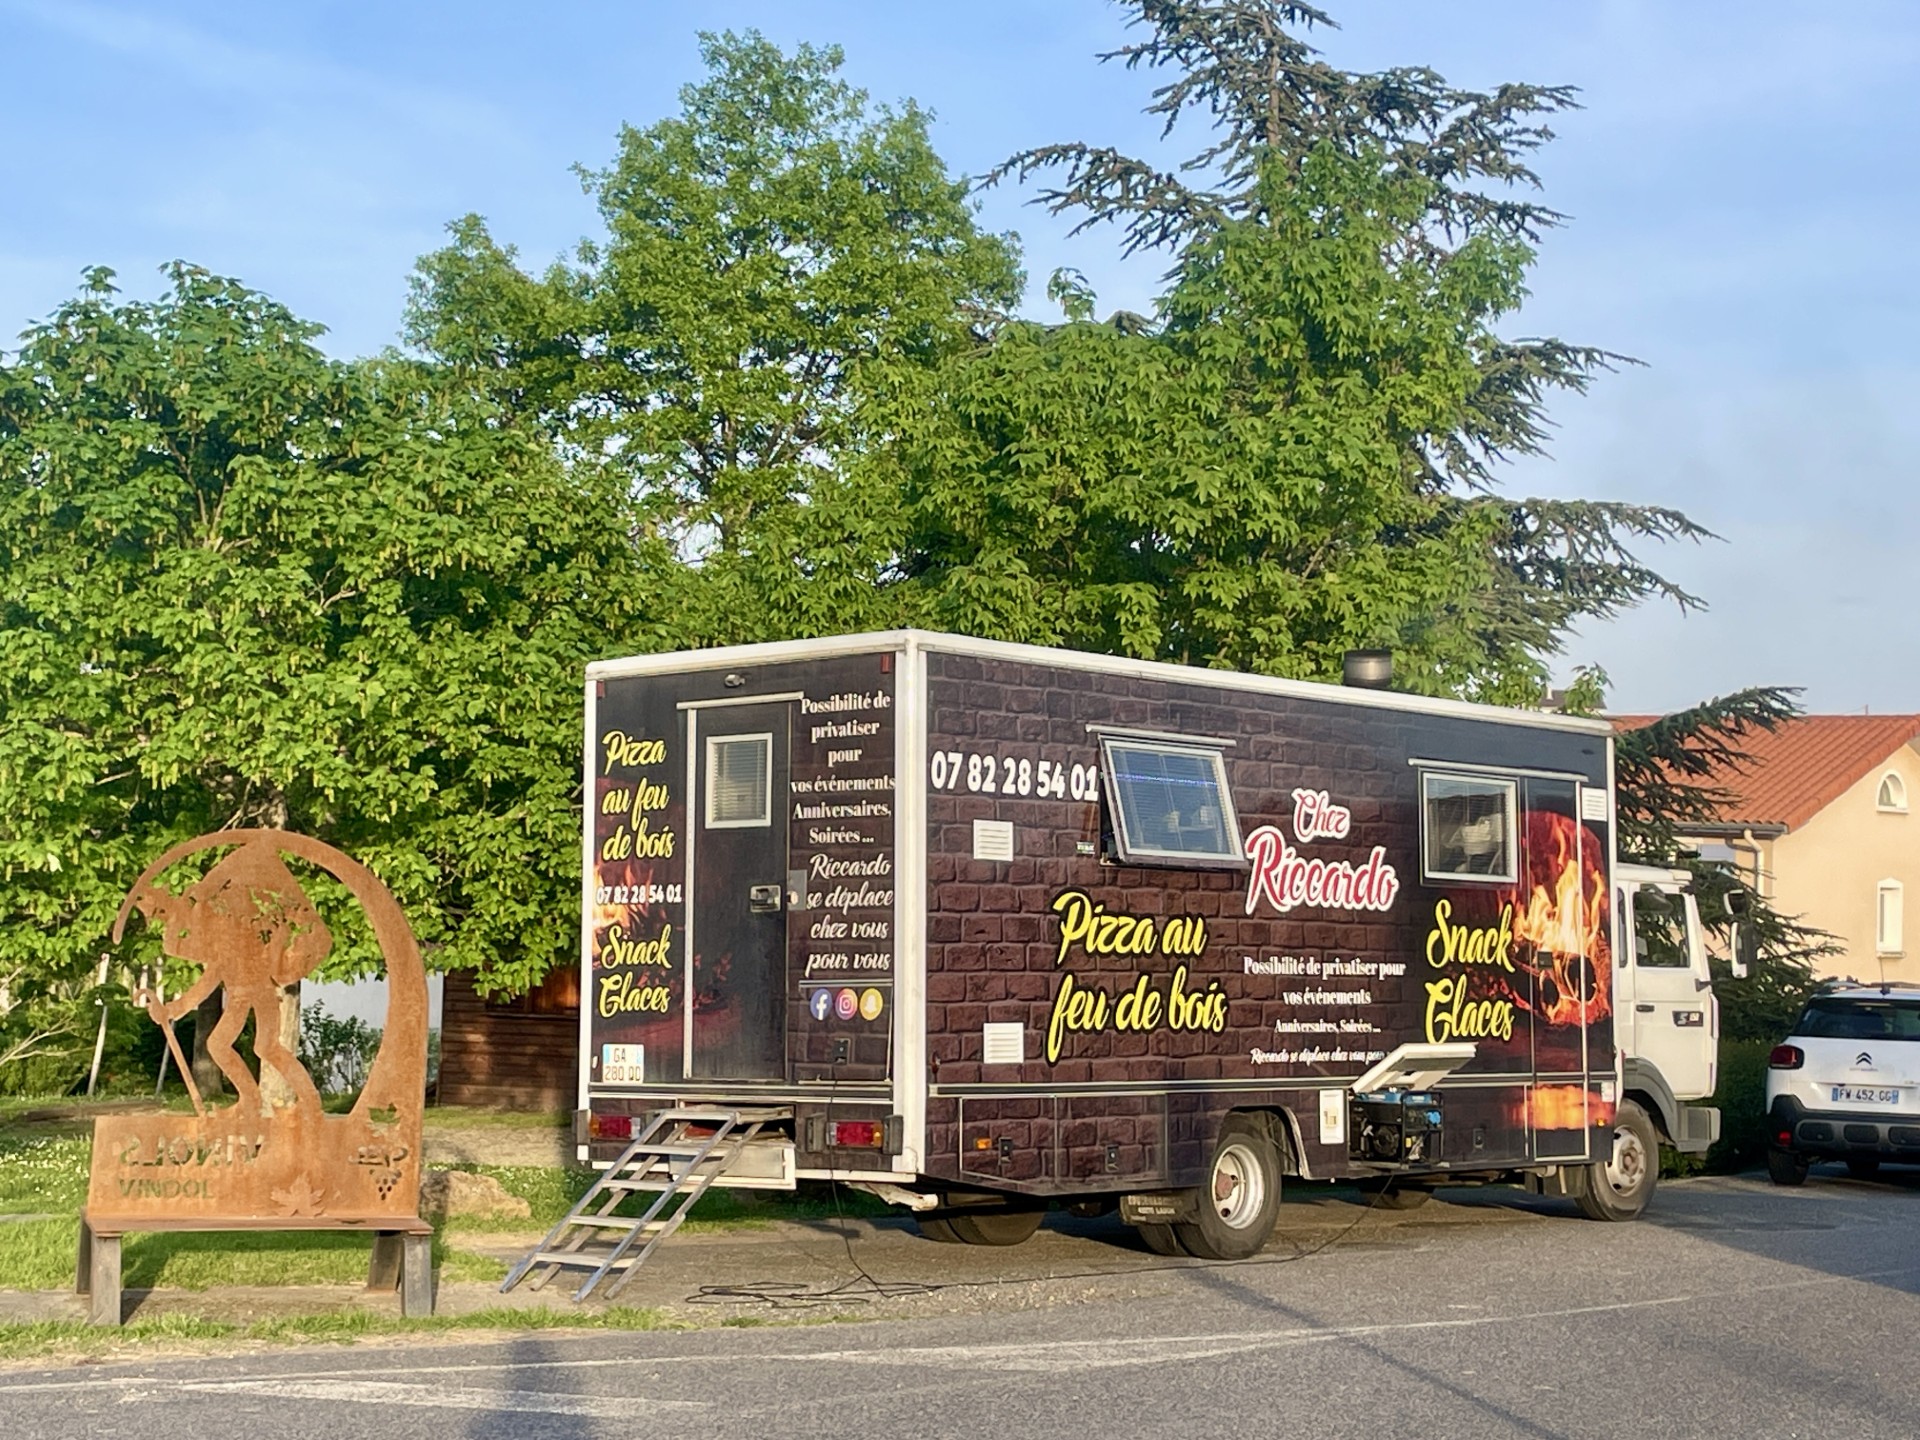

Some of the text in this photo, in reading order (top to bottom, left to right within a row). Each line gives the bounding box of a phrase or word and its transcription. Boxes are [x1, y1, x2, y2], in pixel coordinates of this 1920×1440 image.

[801, 690, 890, 714] Possibilité de
[811, 720, 880, 743] privatiser
[602, 731, 667, 775] Pizza
[828, 748, 862, 767] pour
[791, 774, 896, 793] vos événements
[931, 751, 1098, 801] 07 82 28 54 01
[602, 777, 669, 831] au feu
[793, 799, 891, 819] Anniversaires,
[1292, 788, 1350, 843] Chez
[602, 817, 674, 860] de bois
[809, 853, 891, 880] Riccardo
[1245, 825, 1399, 915] Riccardo
[596, 884, 682, 904] 07 82 28 54 01
[806, 880, 893, 915] se déplace
[810, 914, 889, 939] chez vous
[1052, 892, 1208, 965] Pizza au
[1426, 899, 1516, 973] Snack
[601, 923, 673, 969] Snack
[804, 952, 890, 978] pour vous
[1243, 956, 1407, 981] Possibilité de privatiser pour
[599, 971, 671, 1018] Glaces
[1283, 987, 1372, 1005] vos événements
[1047, 965, 1228, 1063] feu de bois
[1424, 973, 1515, 1044] Glaces
[613, 1047, 627, 1064] GA
[604, 1065, 625, 1081] 280
[119, 1178, 214, 1199] VINDOL
